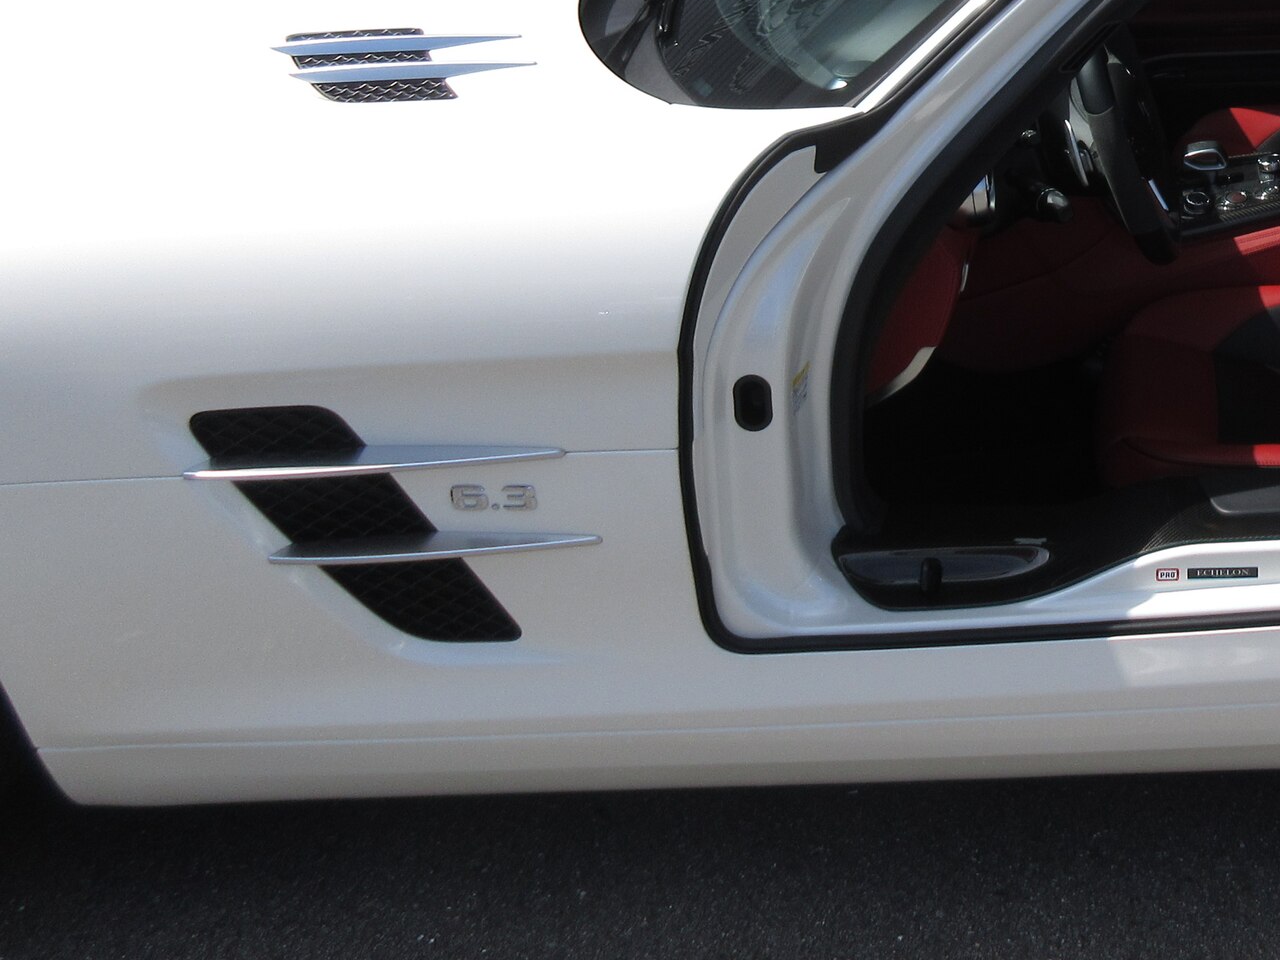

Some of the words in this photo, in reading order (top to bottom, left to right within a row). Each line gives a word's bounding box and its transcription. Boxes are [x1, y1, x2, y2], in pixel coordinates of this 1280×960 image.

[450, 485, 538, 512] 6.3
[1160, 571, 1176, 579] PRO
[1197, 568, 1250, 577] ECHELON
